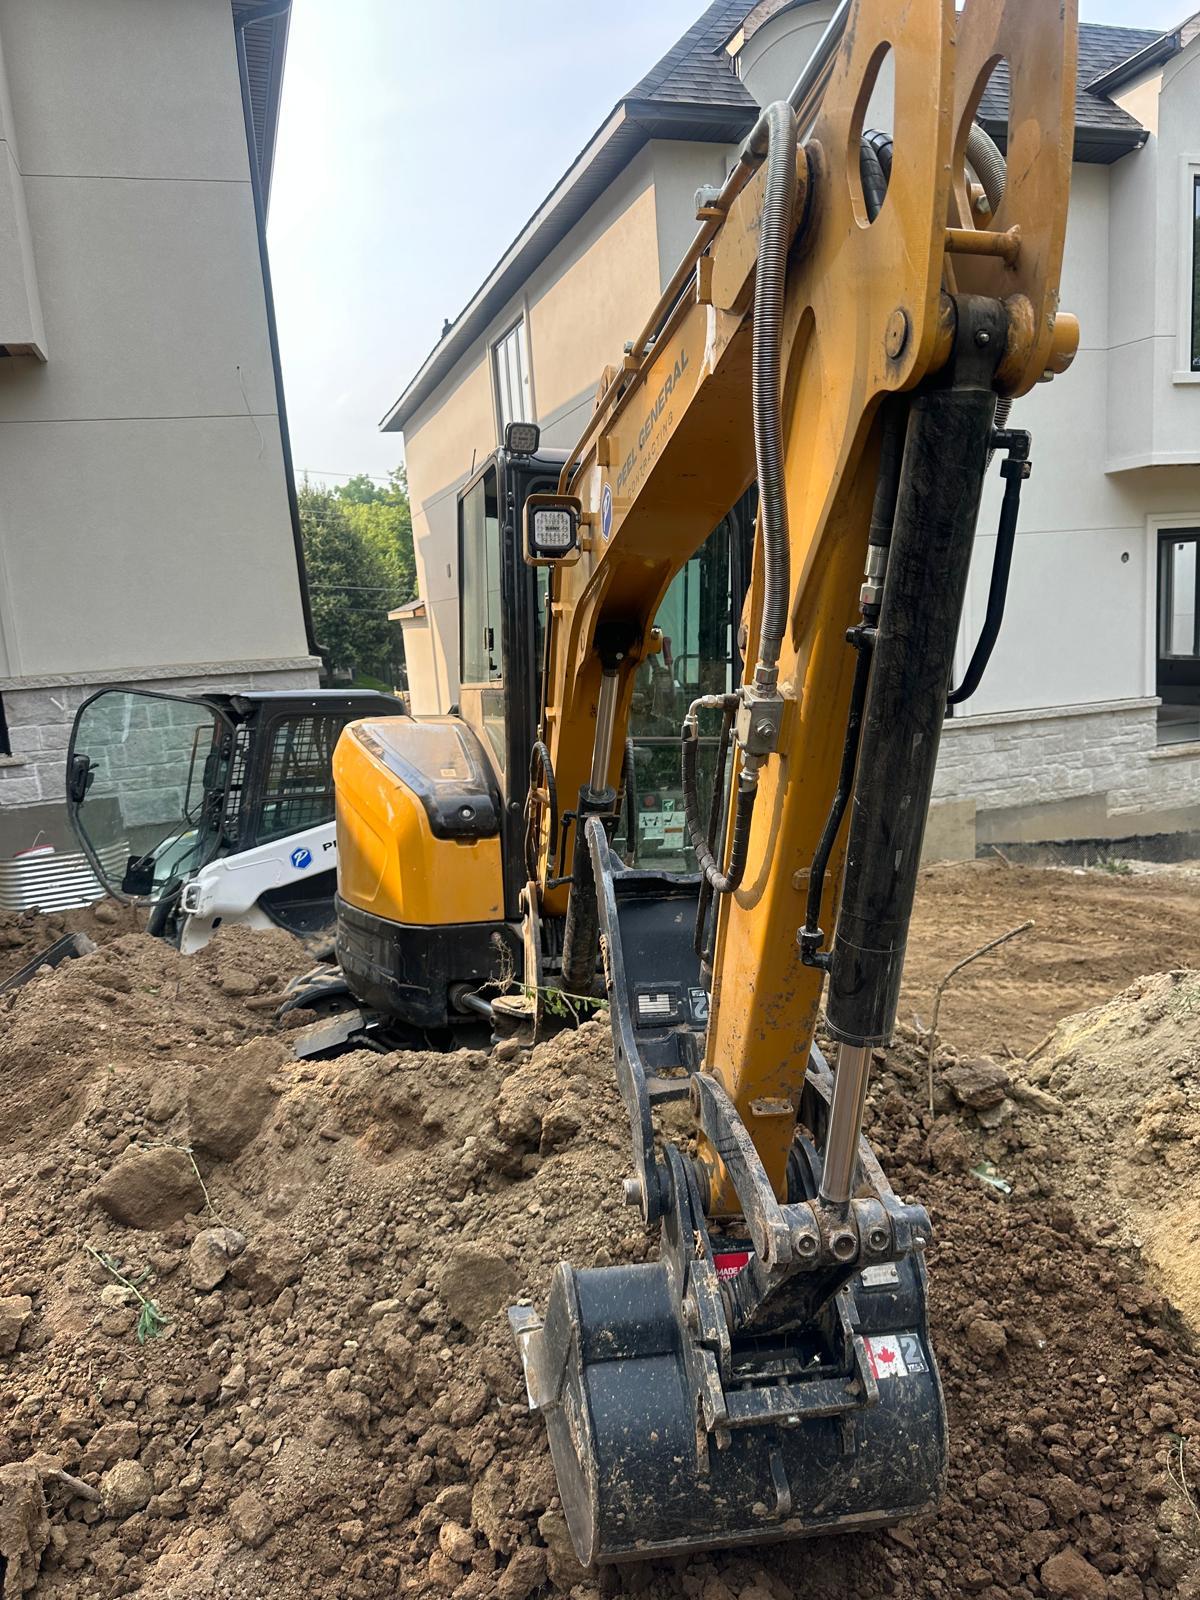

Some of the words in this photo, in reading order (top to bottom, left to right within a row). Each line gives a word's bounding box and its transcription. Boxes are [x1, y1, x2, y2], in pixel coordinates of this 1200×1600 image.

[617, 448, 637, 496] PEEL
[639, 348, 689, 450] GENERAL
[716, 1267, 738, 1276] MADE
[901, 1337, 921, 1363] 2
